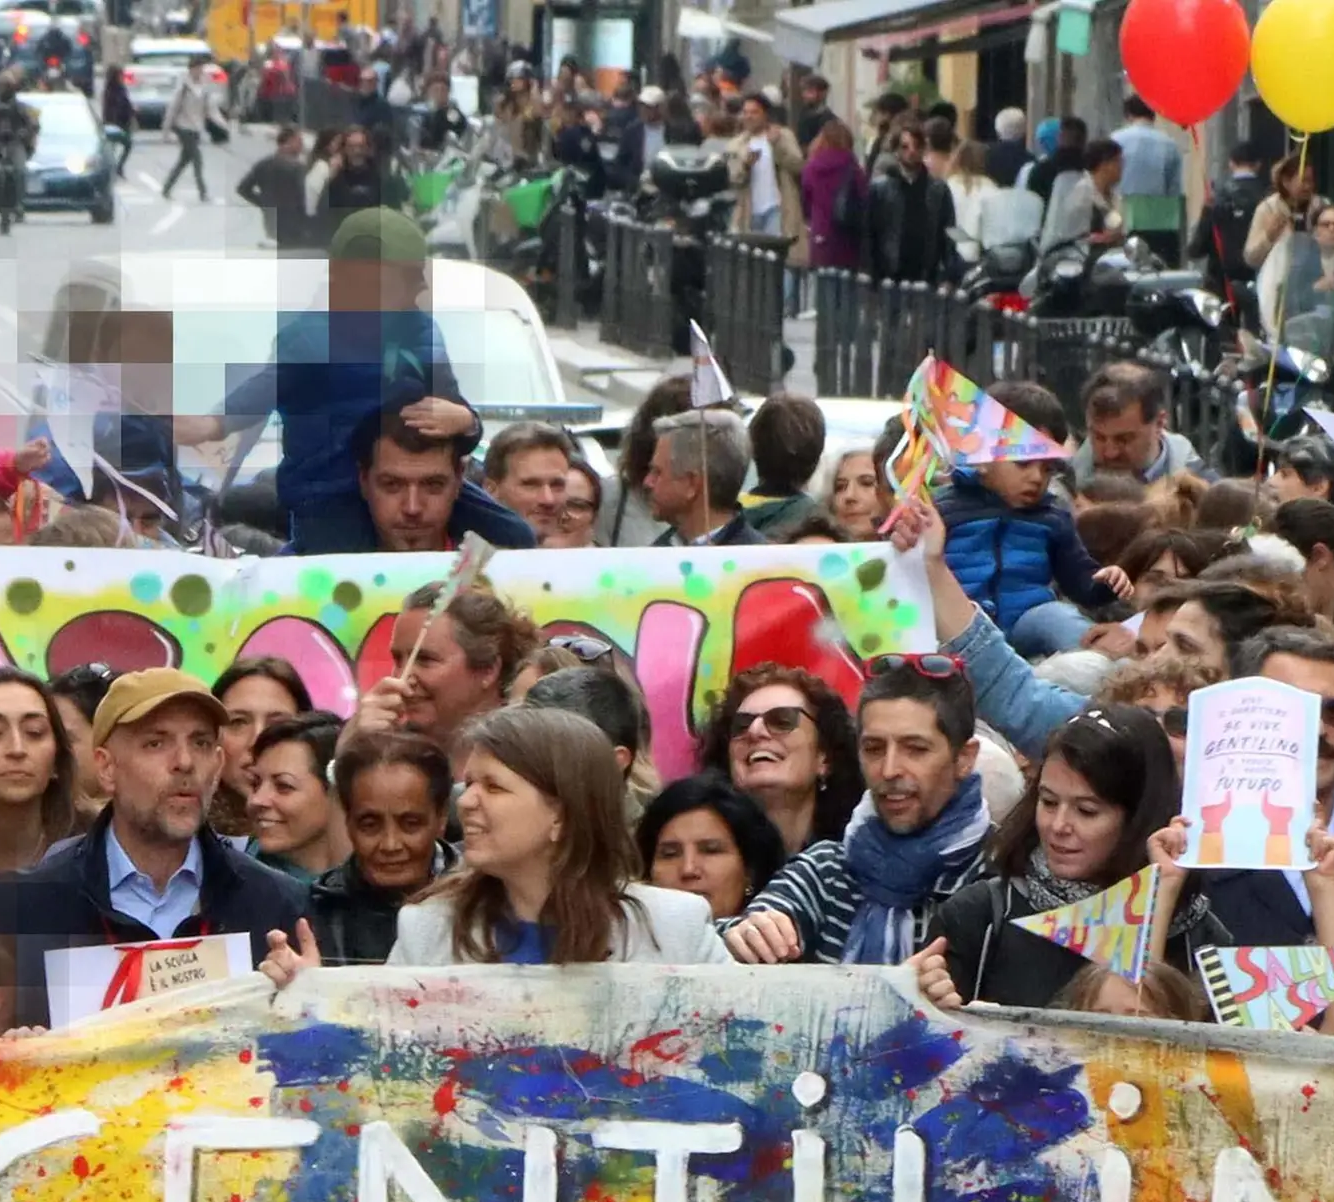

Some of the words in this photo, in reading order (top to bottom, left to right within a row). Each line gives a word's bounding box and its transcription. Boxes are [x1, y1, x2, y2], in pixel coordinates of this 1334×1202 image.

[1204, 736, 1300, 756] GENTILINO
[1215, 776, 1283, 792] FUTURO
[149, 960, 163, 973] LA
[171, 968, 206, 984] NOSTRO
